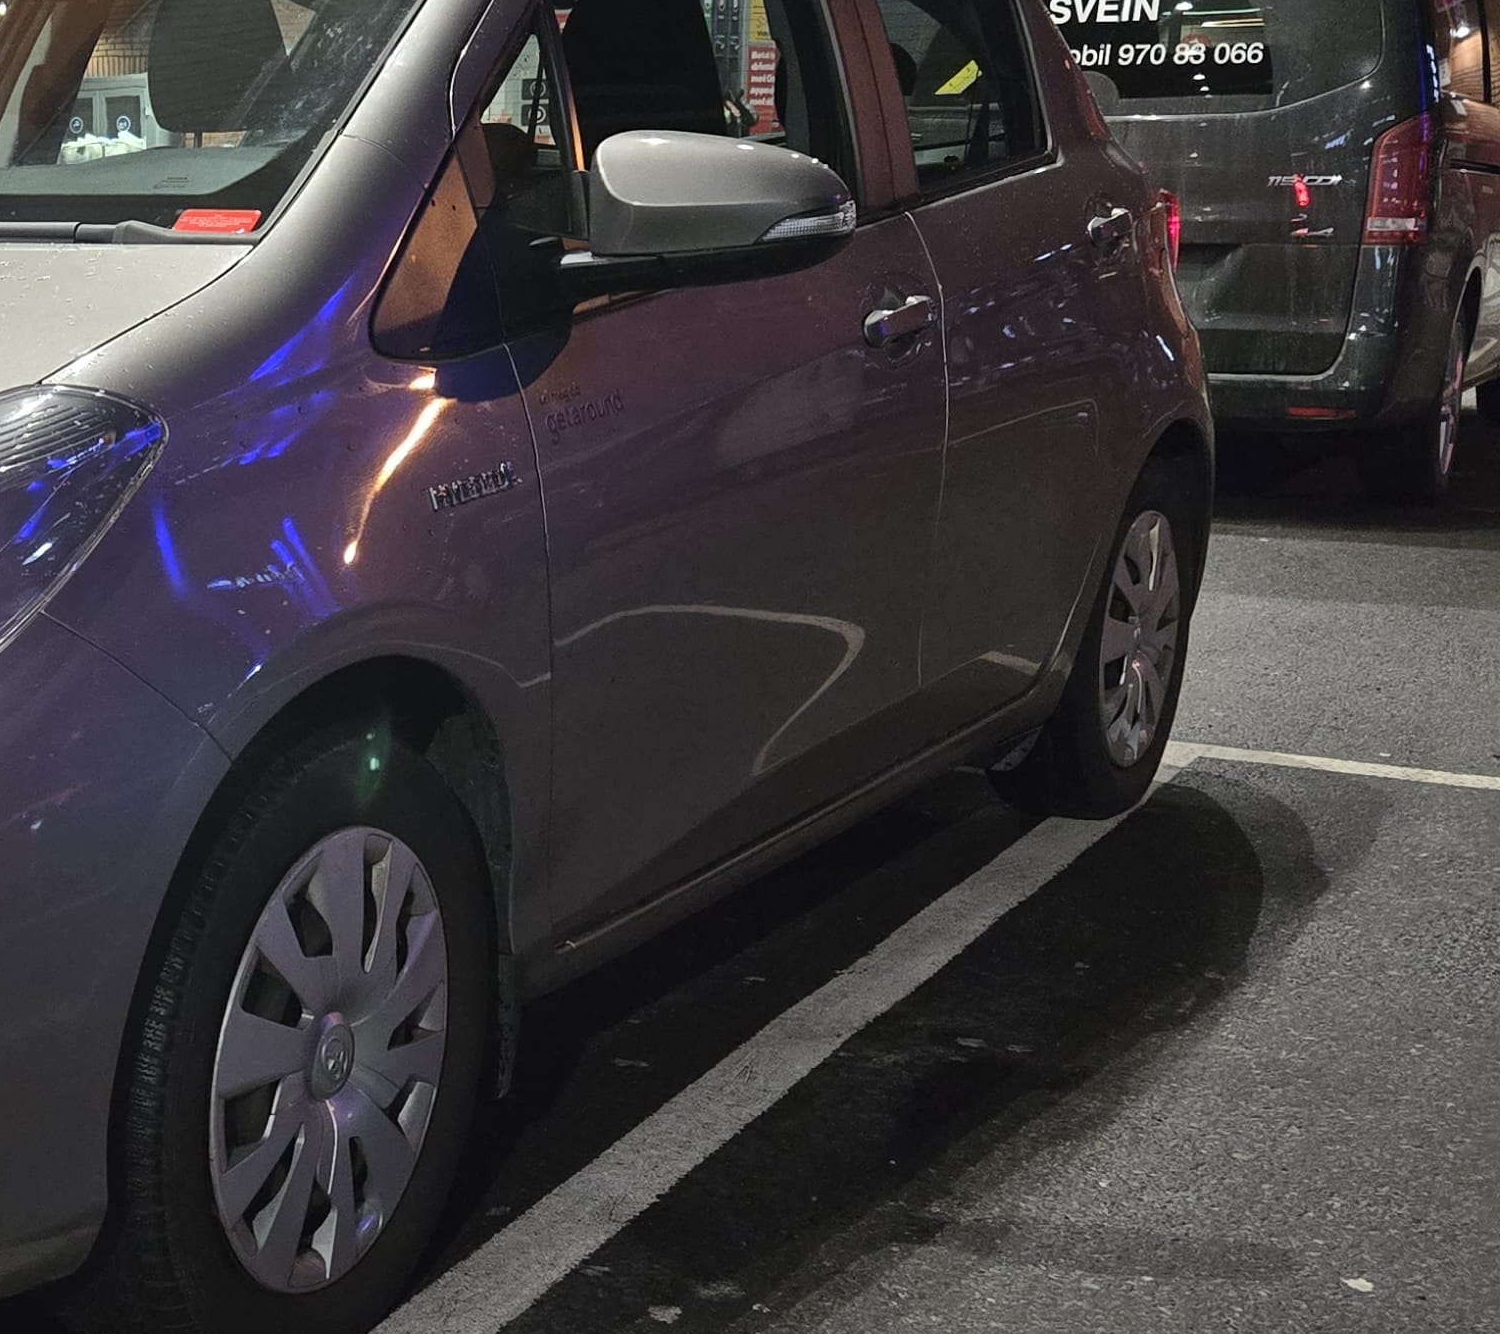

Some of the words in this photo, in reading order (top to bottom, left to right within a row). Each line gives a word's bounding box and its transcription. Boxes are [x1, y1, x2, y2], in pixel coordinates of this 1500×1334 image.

[1070, 44, 1111, 65] obil
[1118, 44, 1166, 65] 970
[1214, 43, 1264, 64] 066
[545, 388, 624, 444] getaround
